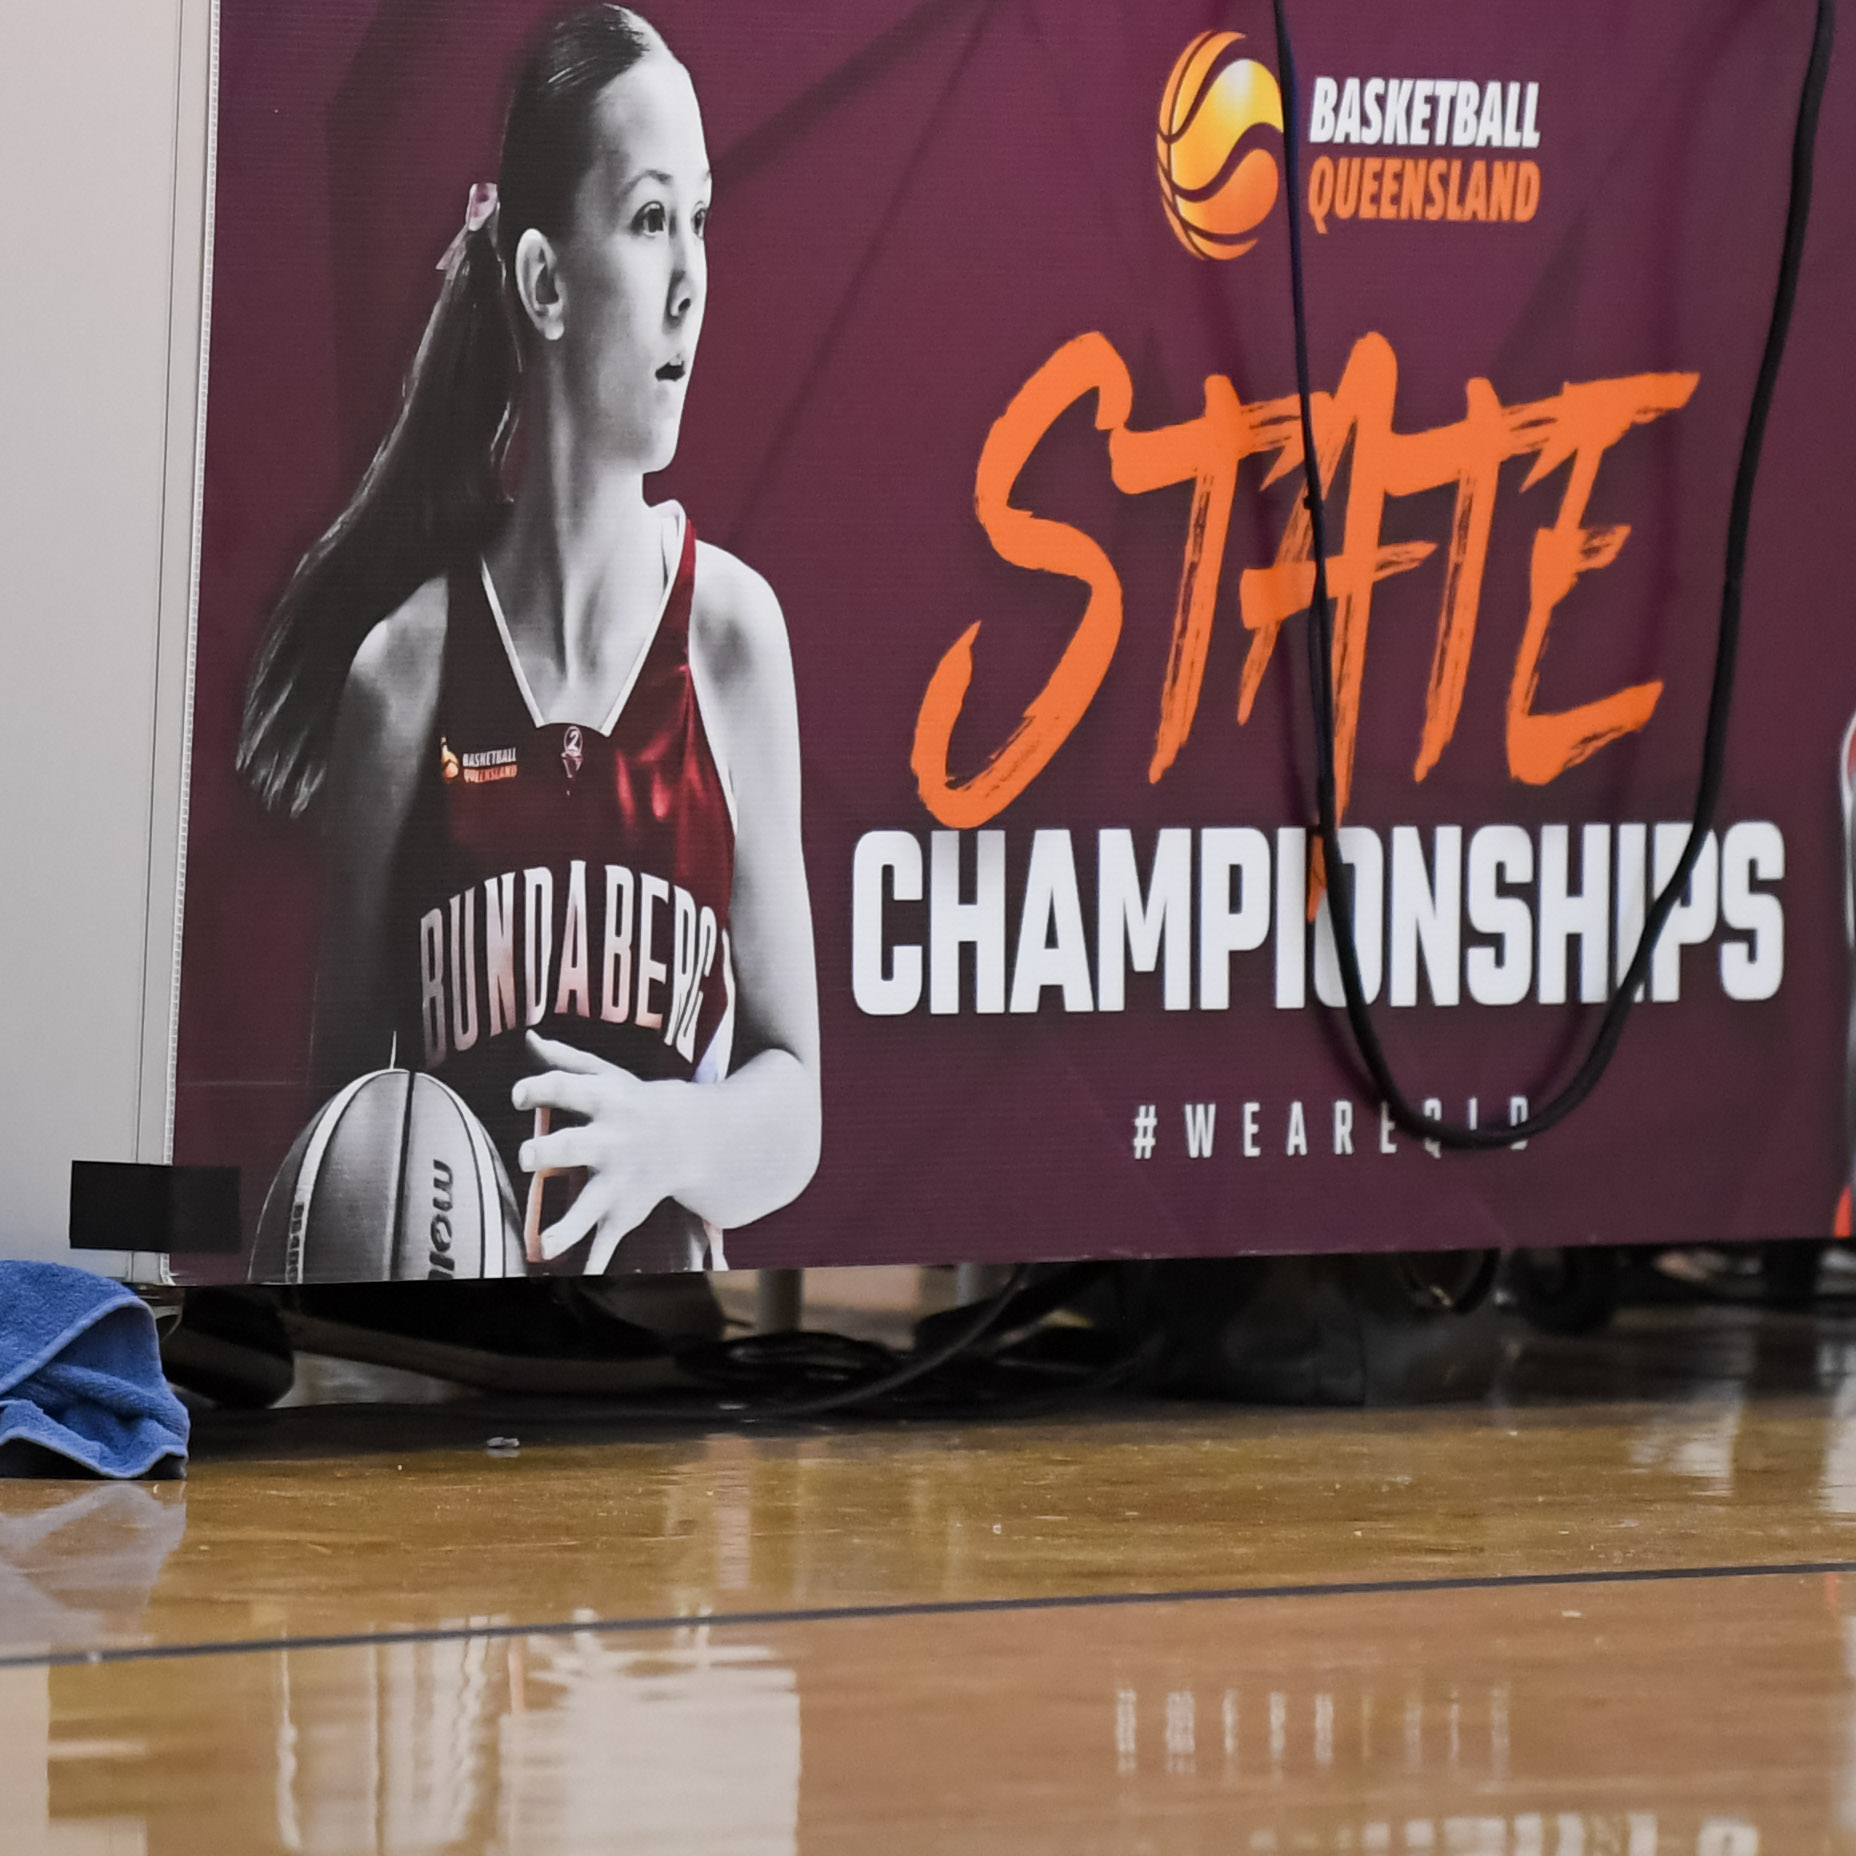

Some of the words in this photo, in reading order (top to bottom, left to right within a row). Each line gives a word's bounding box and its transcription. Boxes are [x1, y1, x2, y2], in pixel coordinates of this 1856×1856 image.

[1308, 76, 1541, 148] BASKETBALL
[1307, 156, 1542, 234] QUEENSLAND
[911, 331, 1700, 924] STATE
[462, 747, 517, 768] BASKETBALL
[420, 860, 718, 1069] BUNDABERG
[851, 820, 1786, 1015] CHAMPIONSHIPS
